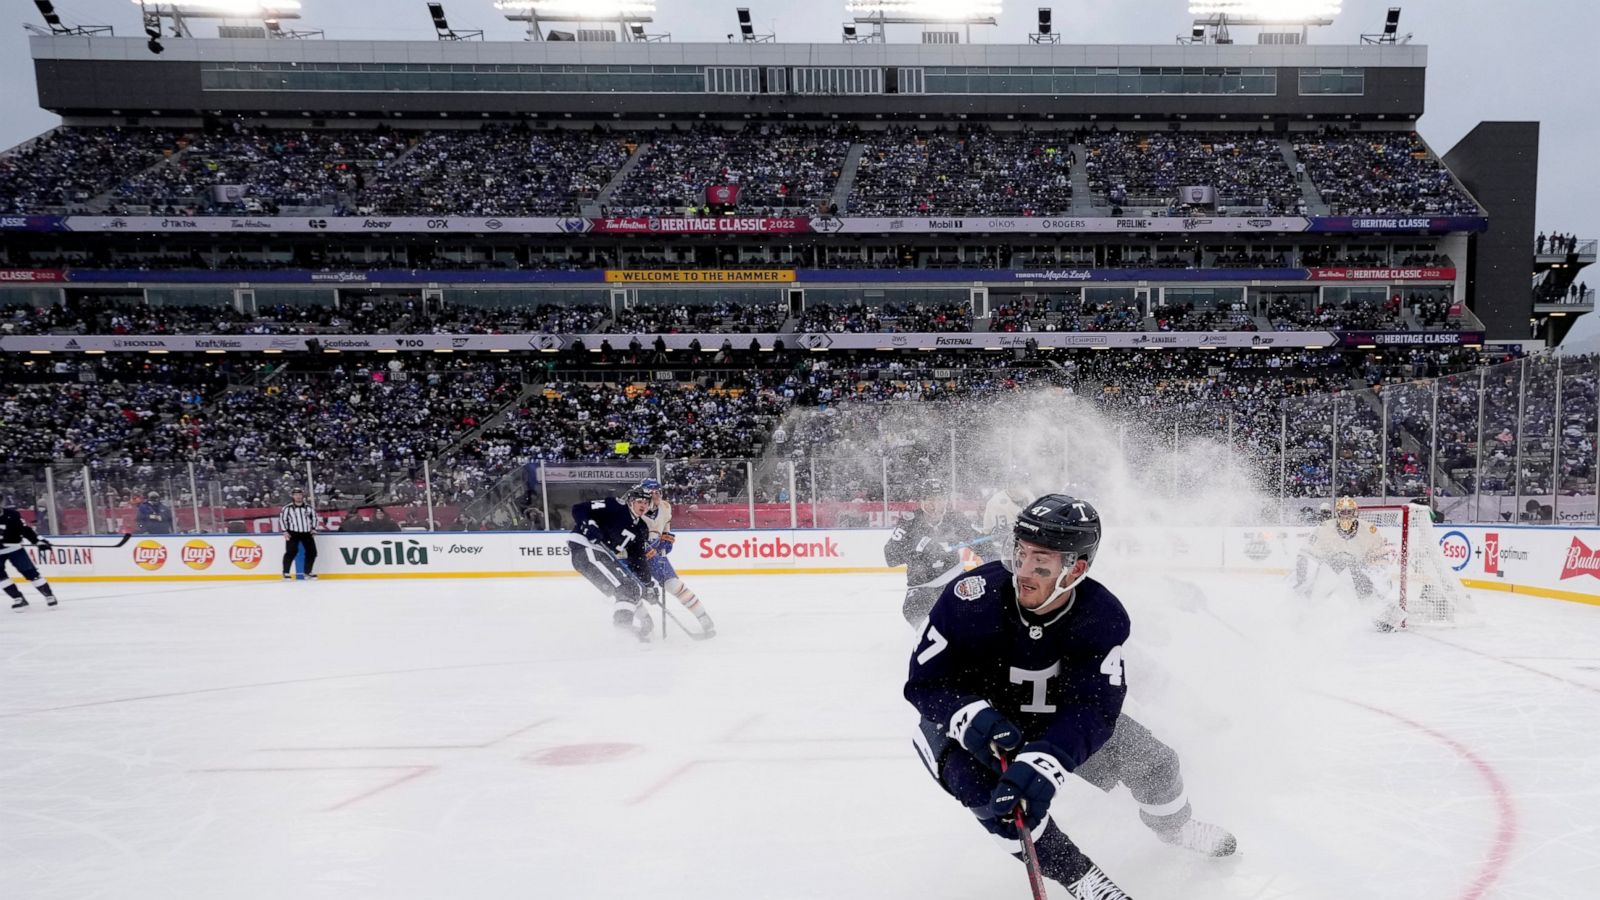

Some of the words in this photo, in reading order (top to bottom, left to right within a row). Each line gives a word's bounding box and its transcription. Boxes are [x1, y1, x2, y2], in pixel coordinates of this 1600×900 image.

[0, 217, 27, 227] ASSIC
[170, 220, 197, 228] TikTok
[362, 219, 392, 229] Sobeys
[604, 219, 620, 230] Tim
[620, 219, 647, 230] Hortons
[660, 218, 717, 231] HERITAGE
[719, 218, 768, 231] CLASSIC
[769, 220, 796, 229] 2022
[928, 220, 953, 229] Mobil
[1052, 220, 1086, 229] ROGERS
[1360, 219, 1396, 228] HERITAGE
[1398, 218, 1430, 228] CLASSIC
[0, 271, 35, 280] CLASSIC
[337, 272, 367, 282] Sabres
[623, 271, 679, 281] WELCOME
[684, 271, 698, 281] TO
[702, 271, 724, 281] THE
[727, 271, 778, 280] HAMMER
[1042, 270, 1069, 280] Maple
[1069, 270, 1092, 280] Leafs
[1354, 269, 1389, 279] HERITAGE
[1391, 269, 1421, 278] CLASSIC
[323, 339, 370, 347] Scotiabank
[405, 339, 424, 347] 100
[935, 336, 973, 345] FASTENAL
[998, 336, 1011, 345] Tim
[1384, 334, 1423, 344] HERITAGE
[1424, 334, 1459, 344] CLASSIC
[615, 470, 646, 478] CLASSIC
[1030, 505, 1052, 516] 47
[891, 527, 906, 541] 5
[340, 539, 428, 565] voilà
[433, 544, 444, 553] by
[447, 543, 484, 555] Sobeys
[519, 546, 543, 556] THE
[547, 546, 570, 556] BES
[699, 537, 840, 559] Scotiabank
[28, 548, 94, 565] ANADIAN
[135, 545, 165, 564] Lay's
[183, 545, 214, 563] Lay's
[231, 544, 262, 563] Lay's
[1499, 546, 1528, 565] optimum
[1009, 660, 1061, 713] T
